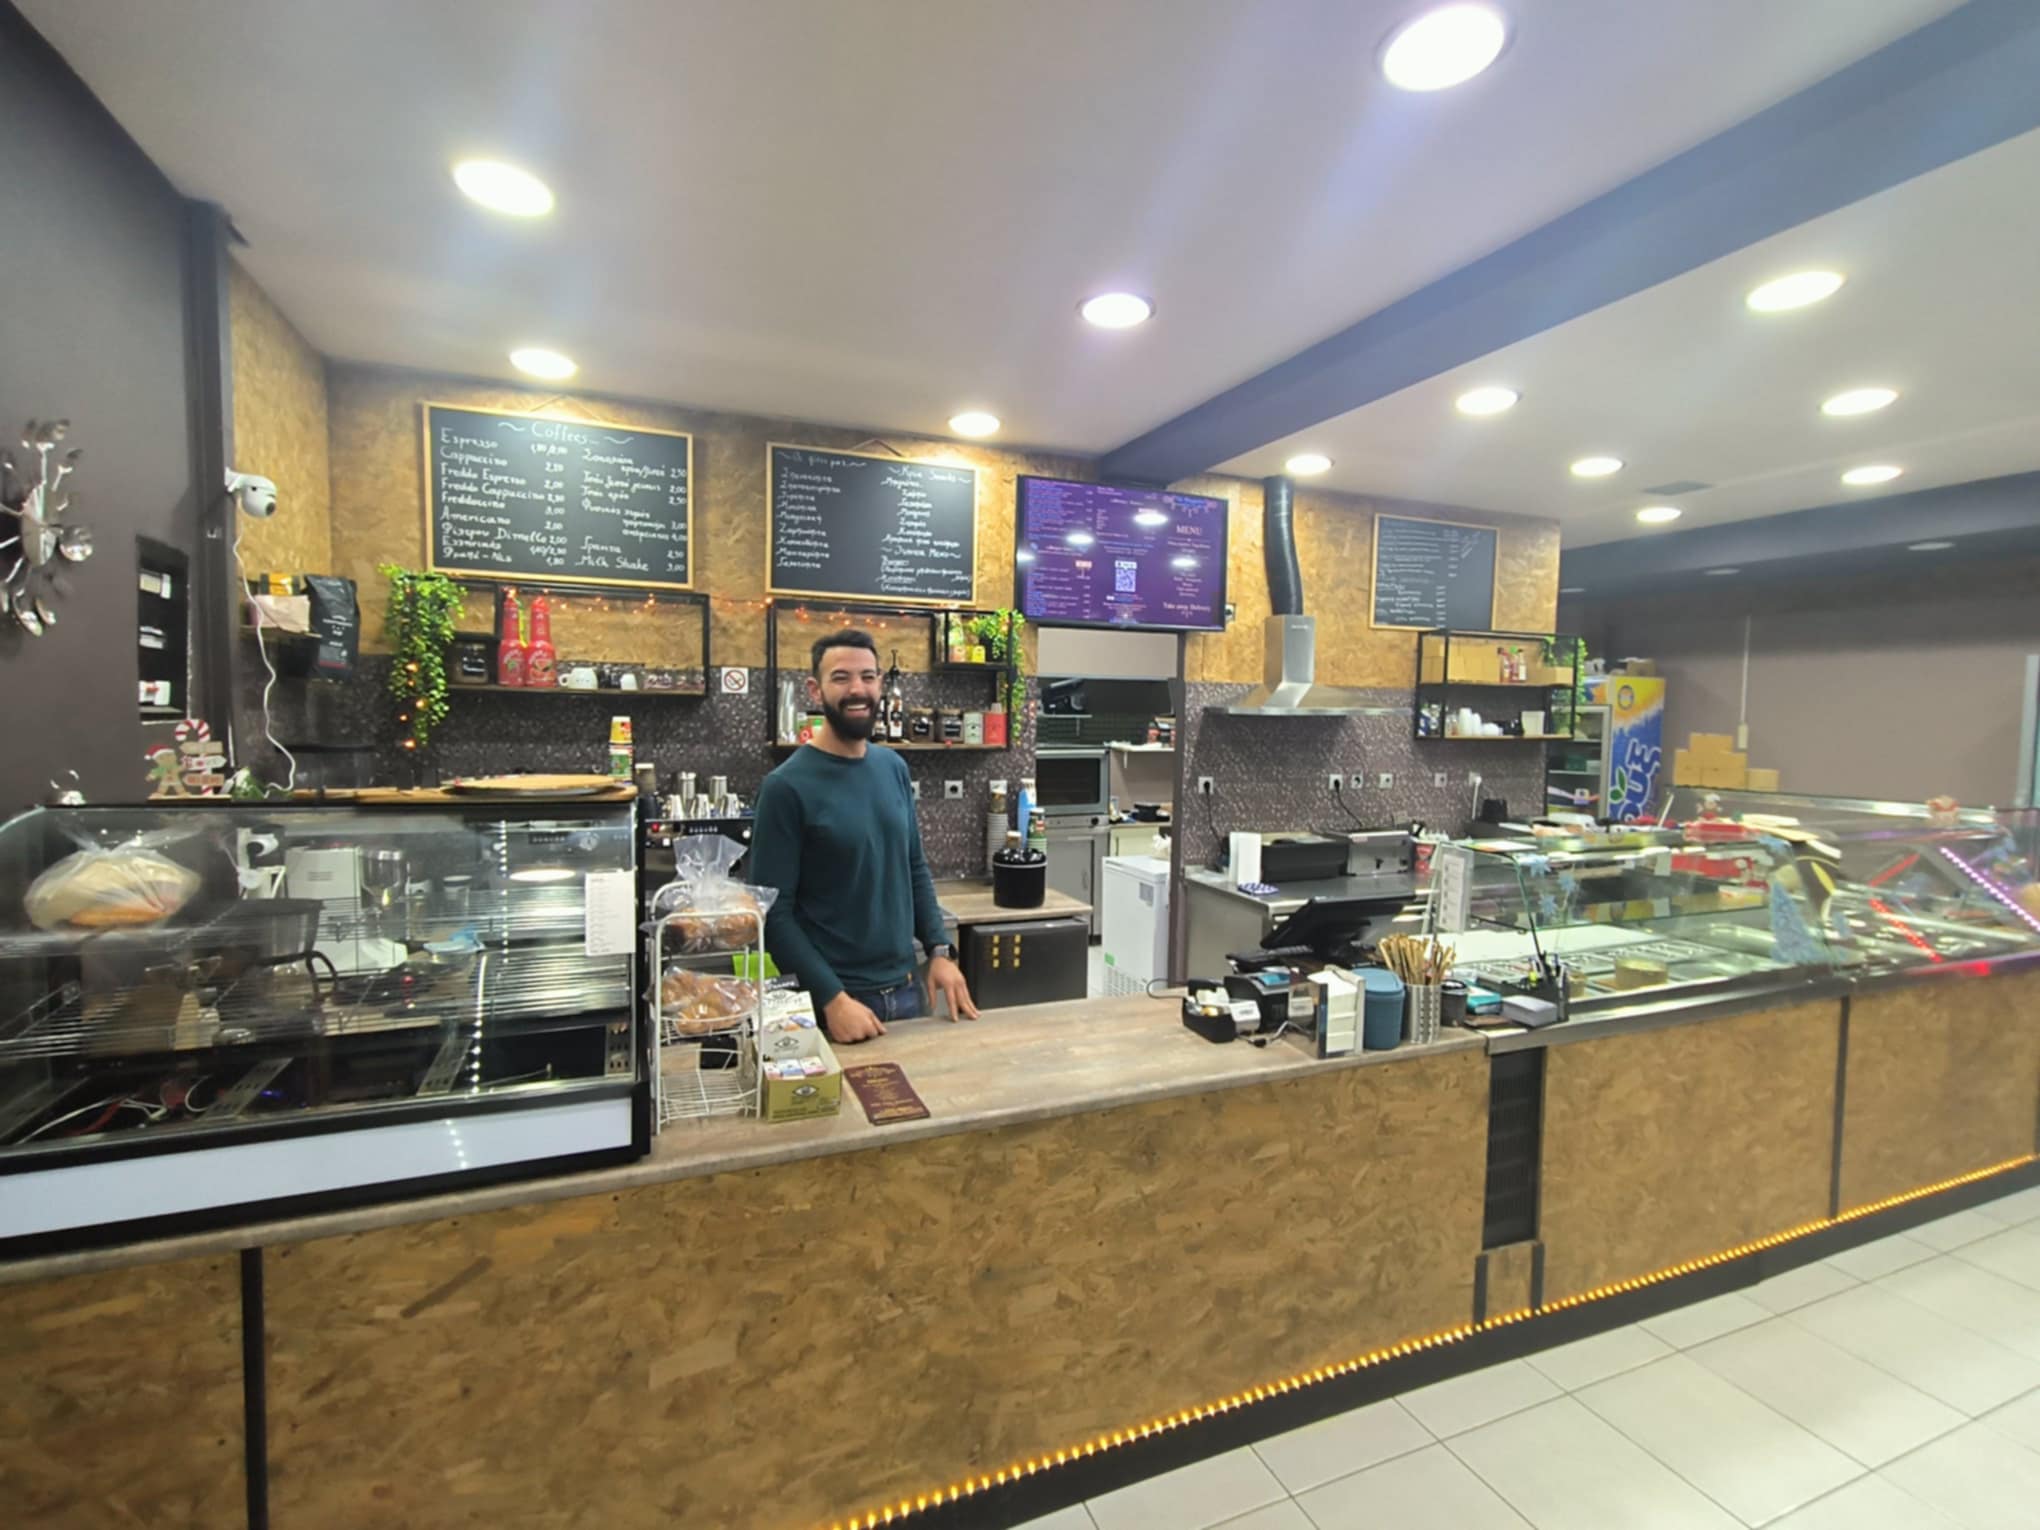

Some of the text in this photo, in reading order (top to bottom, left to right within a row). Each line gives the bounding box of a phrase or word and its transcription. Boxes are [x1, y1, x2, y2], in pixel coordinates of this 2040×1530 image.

[441, 427, 499, 450] Espresso
[440, 446, 508, 467] Cappuccino
[441, 462, 479, 479] Freddo
[482, 467, 527, 486] Espresso
[441, 477, 480, 493] Freddo
[482, 482, 546, 502] Cappuccino
[440, 504, 511, 525] Americano
[616, 556, 649, 573] Shake
